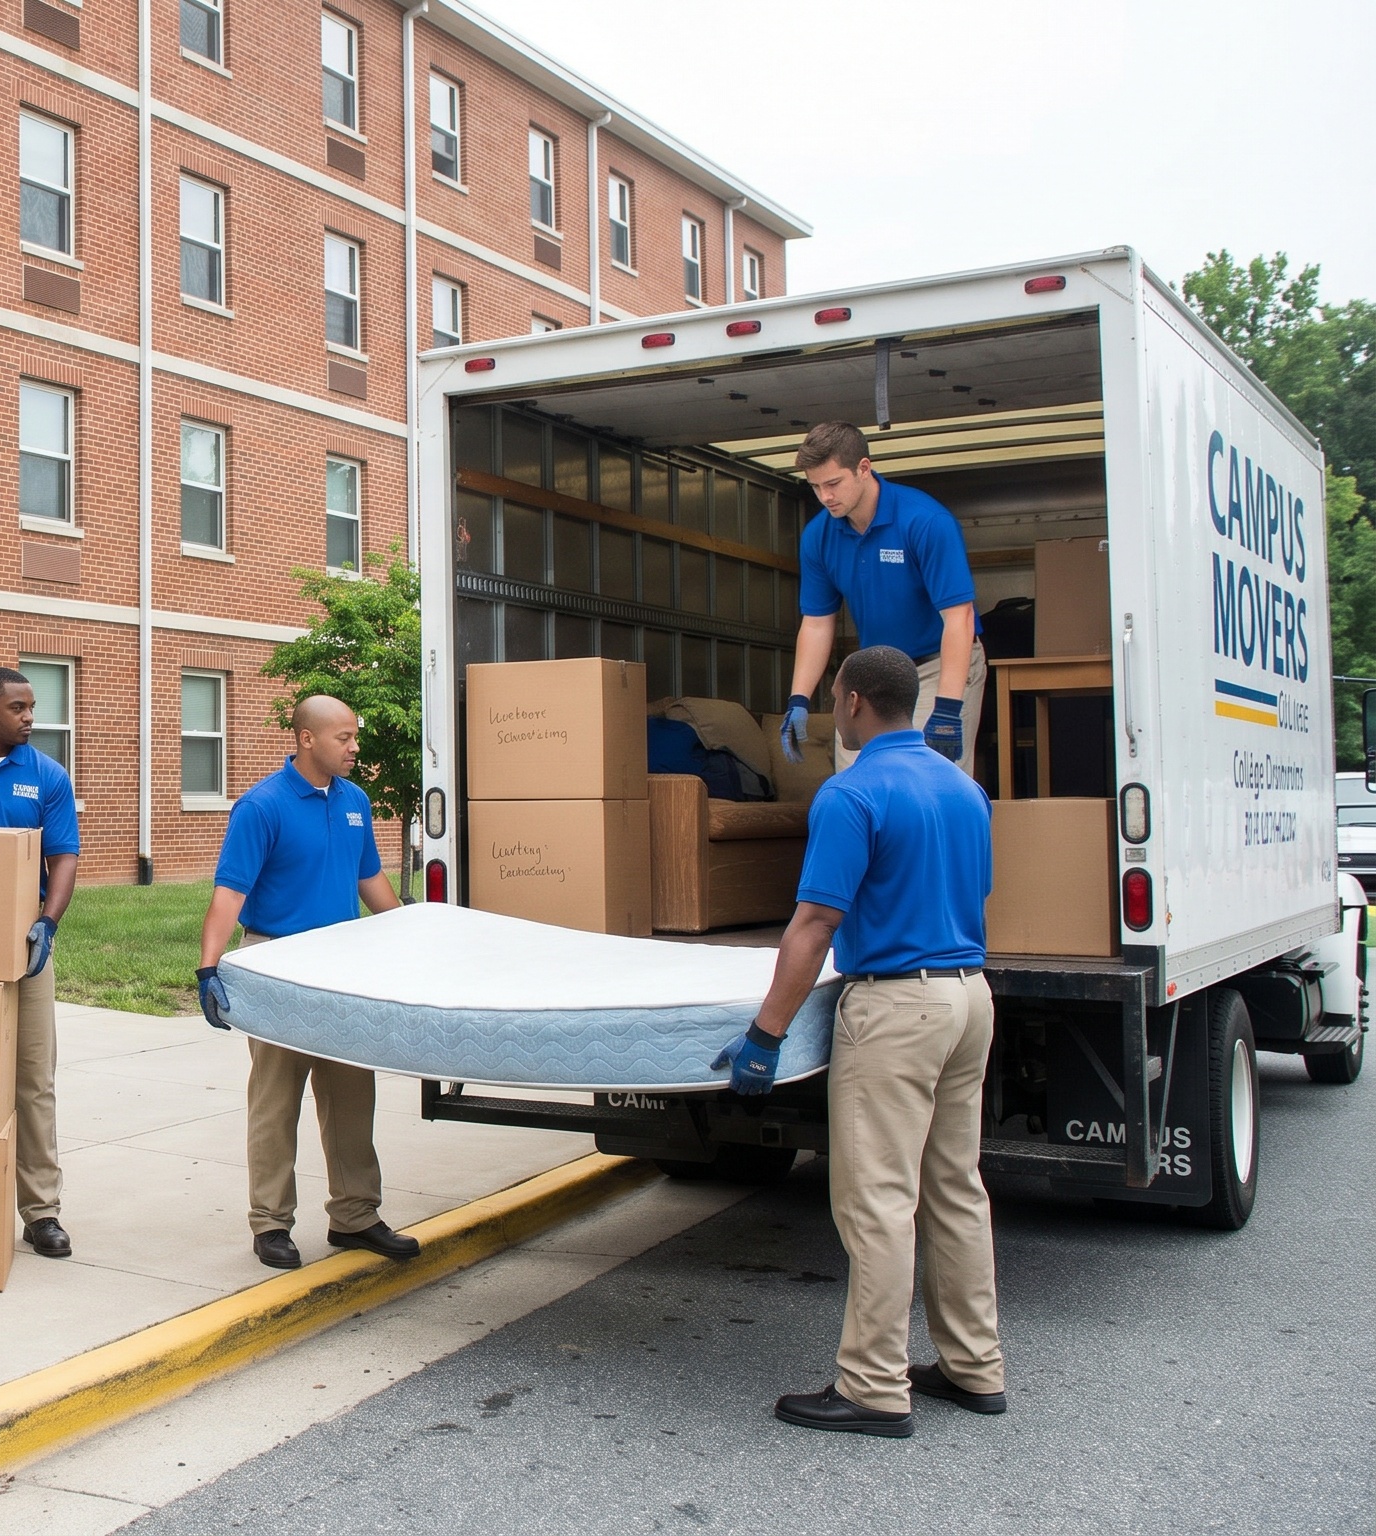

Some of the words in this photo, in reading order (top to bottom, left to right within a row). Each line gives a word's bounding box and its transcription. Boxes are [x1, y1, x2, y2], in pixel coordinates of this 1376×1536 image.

[1208, 430, 1306, 584] CAMPUS
[1212, 551, 1309, 684] MOVERS
[1065, 1119, 1192, 1149] CAMUS
